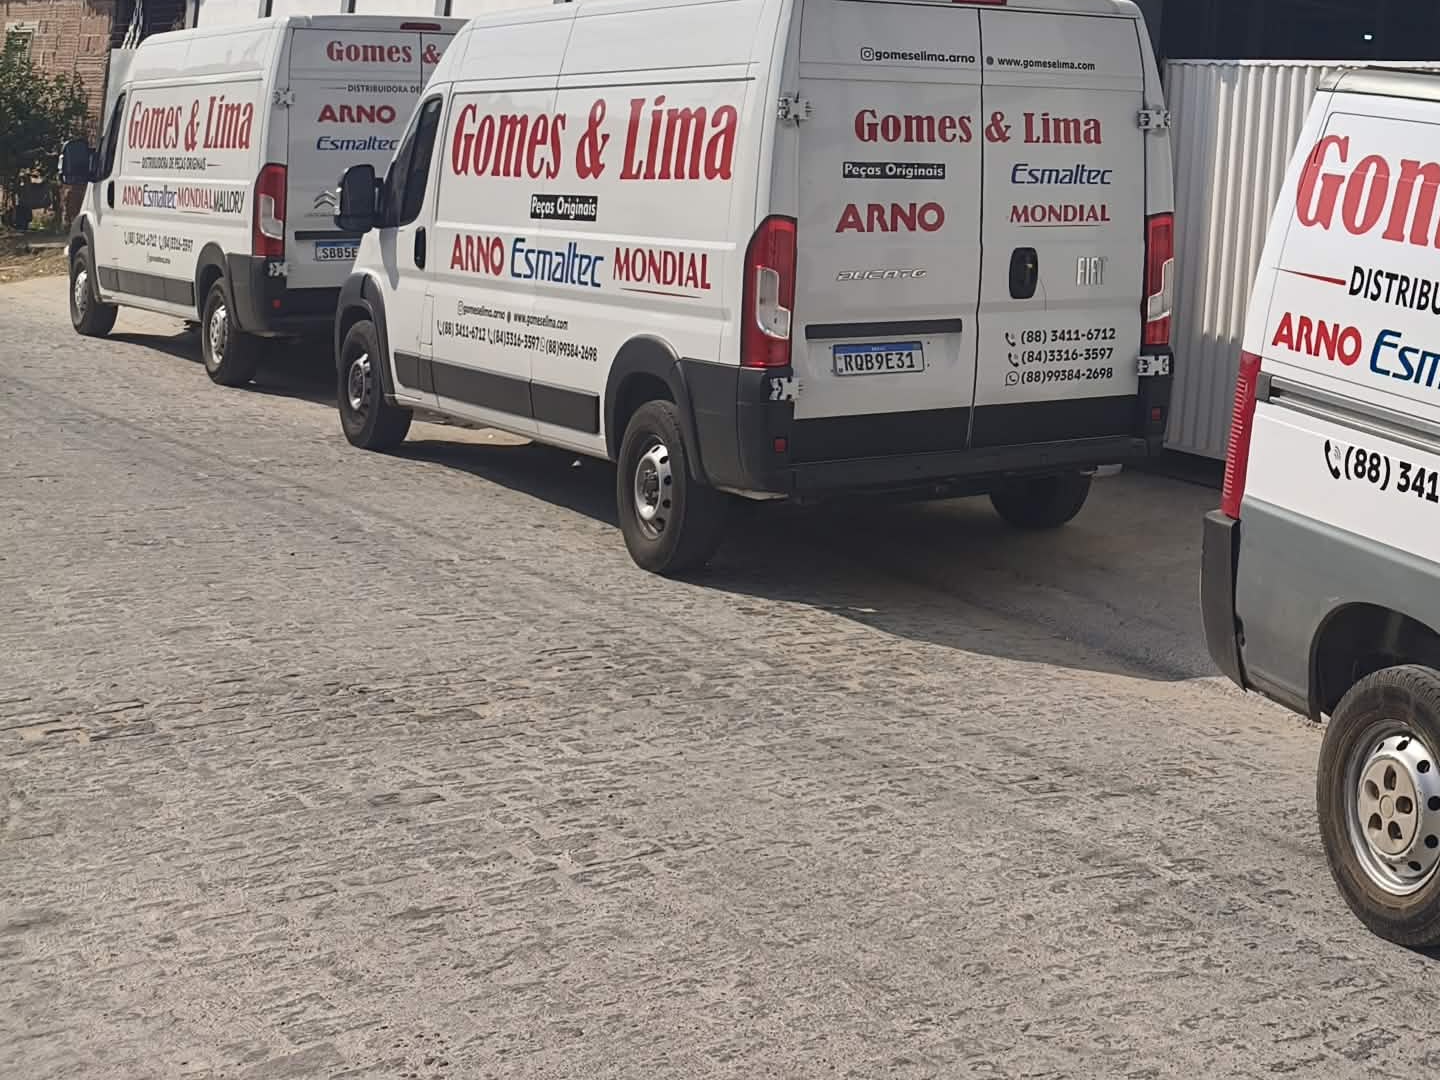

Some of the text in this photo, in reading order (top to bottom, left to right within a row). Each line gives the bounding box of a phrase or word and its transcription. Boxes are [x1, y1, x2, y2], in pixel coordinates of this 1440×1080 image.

[327, 40, 441, 64] Gomes &
[875, 50, 976, 64] gomeselima.arno
[997, 58, 1095, 71] www.gomeselima.com
[347, 84, 408, 93] DISTRIBUIDORA
[128, 95, 253, 152] Gomes & Lima
[318, 104, 396, 124] ARNO
[854, 109, 1102, 145] Gomes & Lima
[316, 136, 400, 151] Esmaltec
[451, 95, 738, 180] Gomes & Lima
[844, 163, 944, 179] Peças Originais
[1011, 163, 1112, 185] Esmaltec
[122, 184, 245, 213] ARNO Esmaltec MONDIAL MALLORY
[531, 196, 596, 219] Peças Originais
[835, 202, 945, 233] ARNO
[1010, 204, 1111, 223] MONDIAL
[450, 233, 711, 290] ARNO Esmaltec MONDIAL
[442, 322, 454, 338] (88)
[455, 322, 486, 342] 3411-6712
[1021, 328, 1116, 345] (88) 3411-6712
[1272, 311, 1362, 366] ARNO
[844, 352, 915, 371] RQB9E31
[1021, 348, 1113, 364] (84)3316-3597
[1021, 368, 1113, 384] (88)99384-2698
[1344, 445, 1390, 491] (88)
